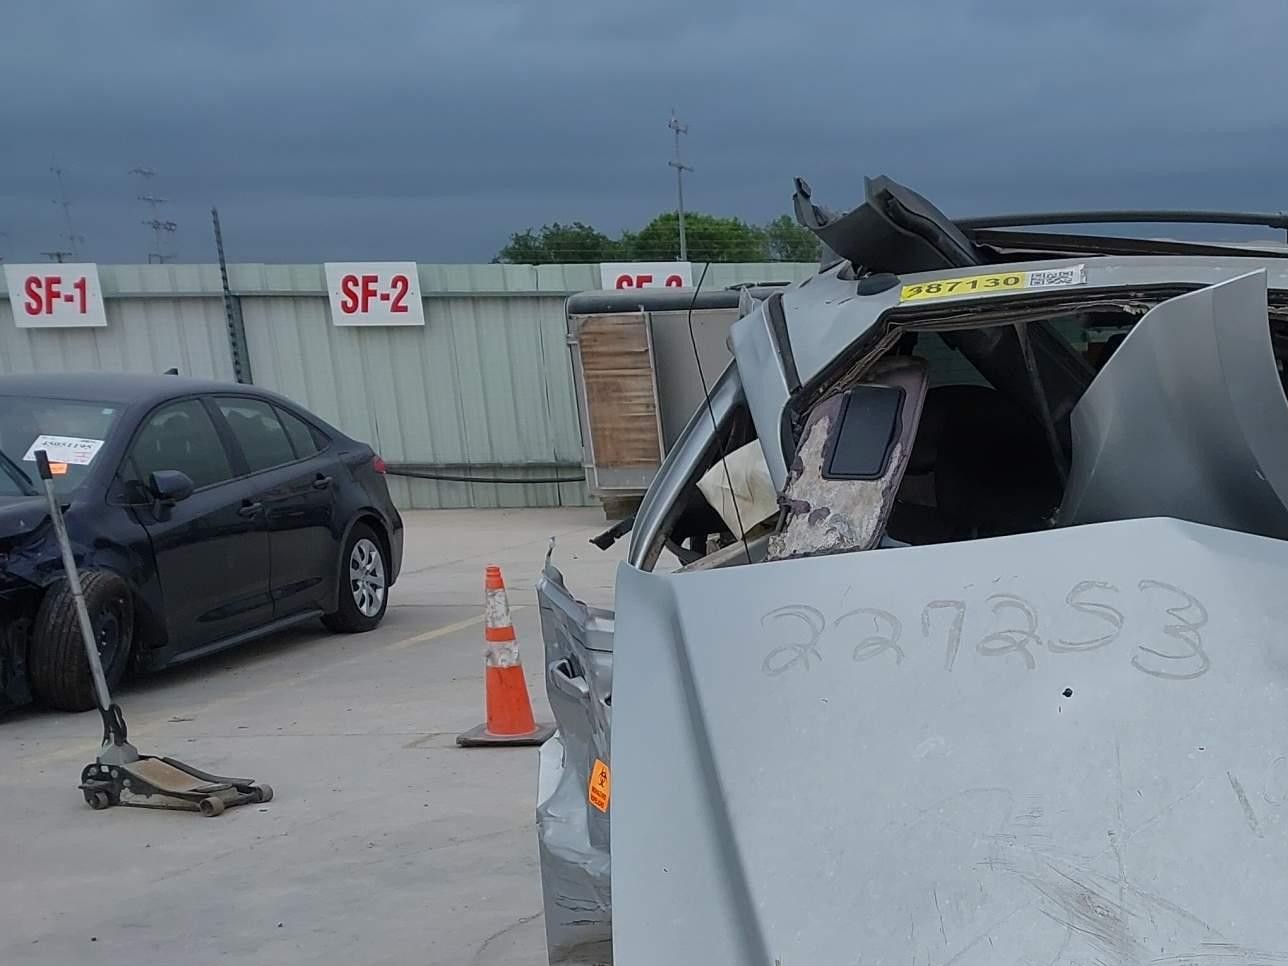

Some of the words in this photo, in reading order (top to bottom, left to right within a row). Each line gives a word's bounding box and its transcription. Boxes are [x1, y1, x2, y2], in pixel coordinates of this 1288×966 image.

[24, 276, 87, 316] SF-1
[340, 274, 409, 314] SF-2
[906, 275, 1021, 299] 387130
